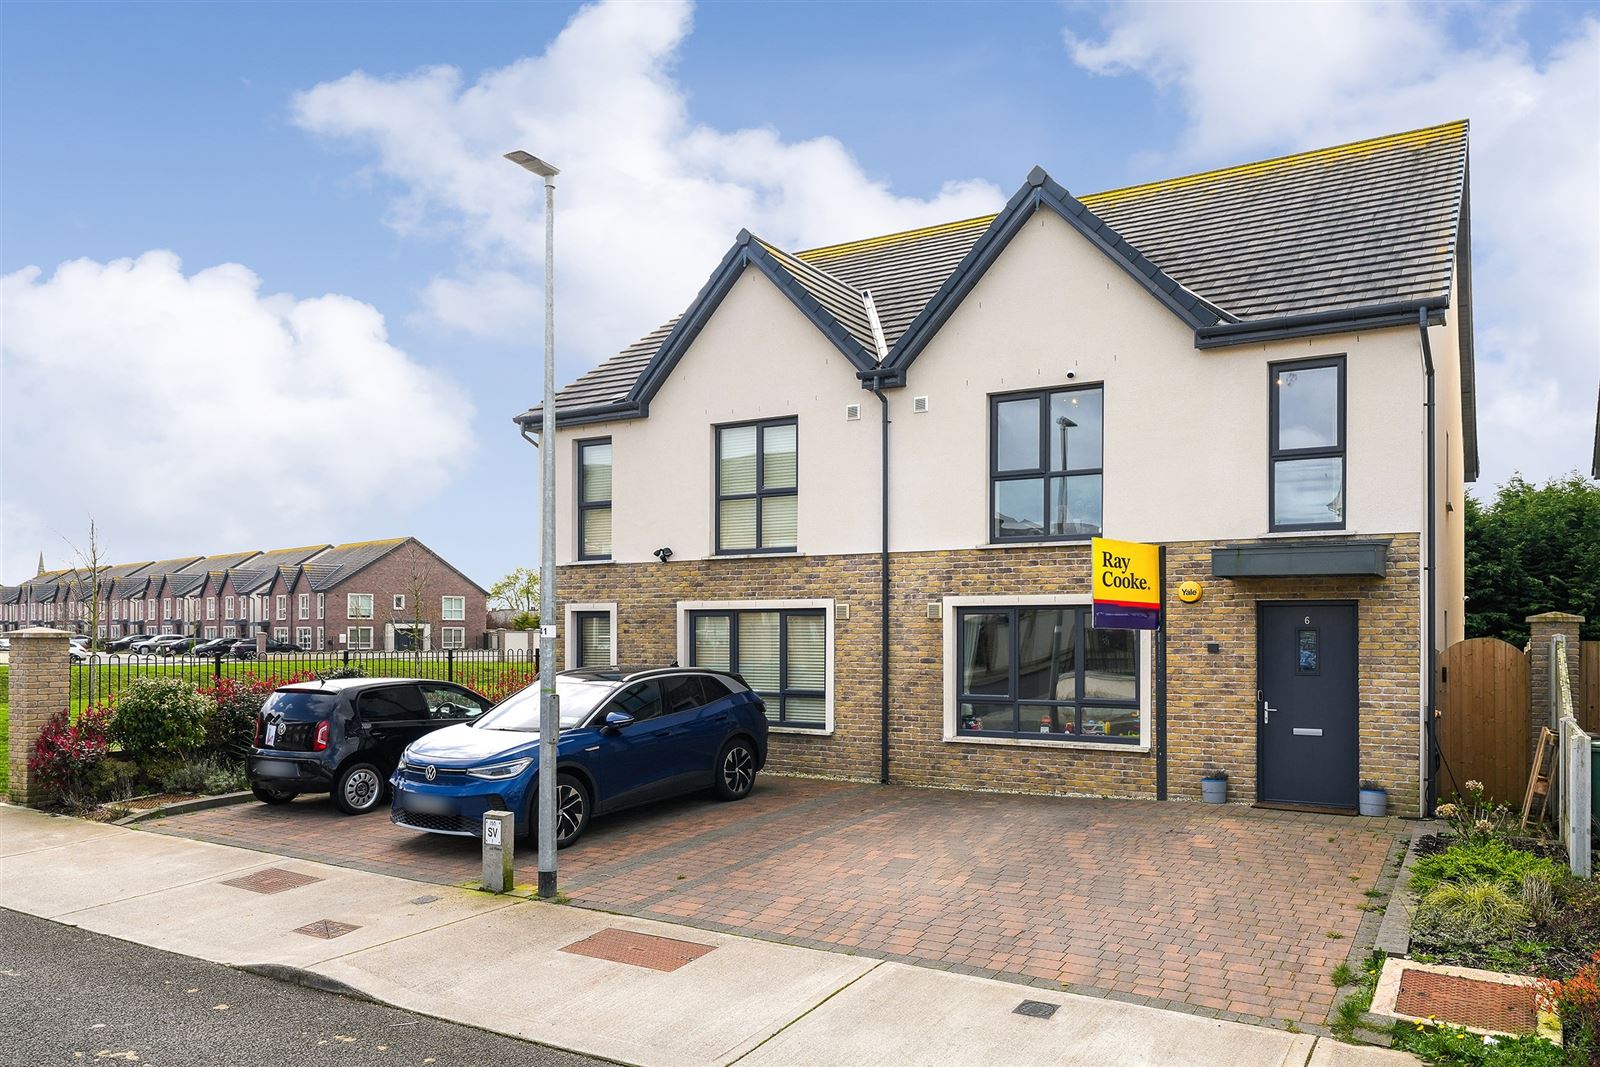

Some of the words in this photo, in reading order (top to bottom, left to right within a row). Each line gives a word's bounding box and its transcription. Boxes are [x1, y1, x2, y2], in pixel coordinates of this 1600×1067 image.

[1102, 551, 1131, 574] Ray
[1102, 571, 1151, 591] Cooke.
[1181, 588, 1197, 597] Yale
[1304, 616, 1311, 625] 6
[487, 827, 498, 838] SV
